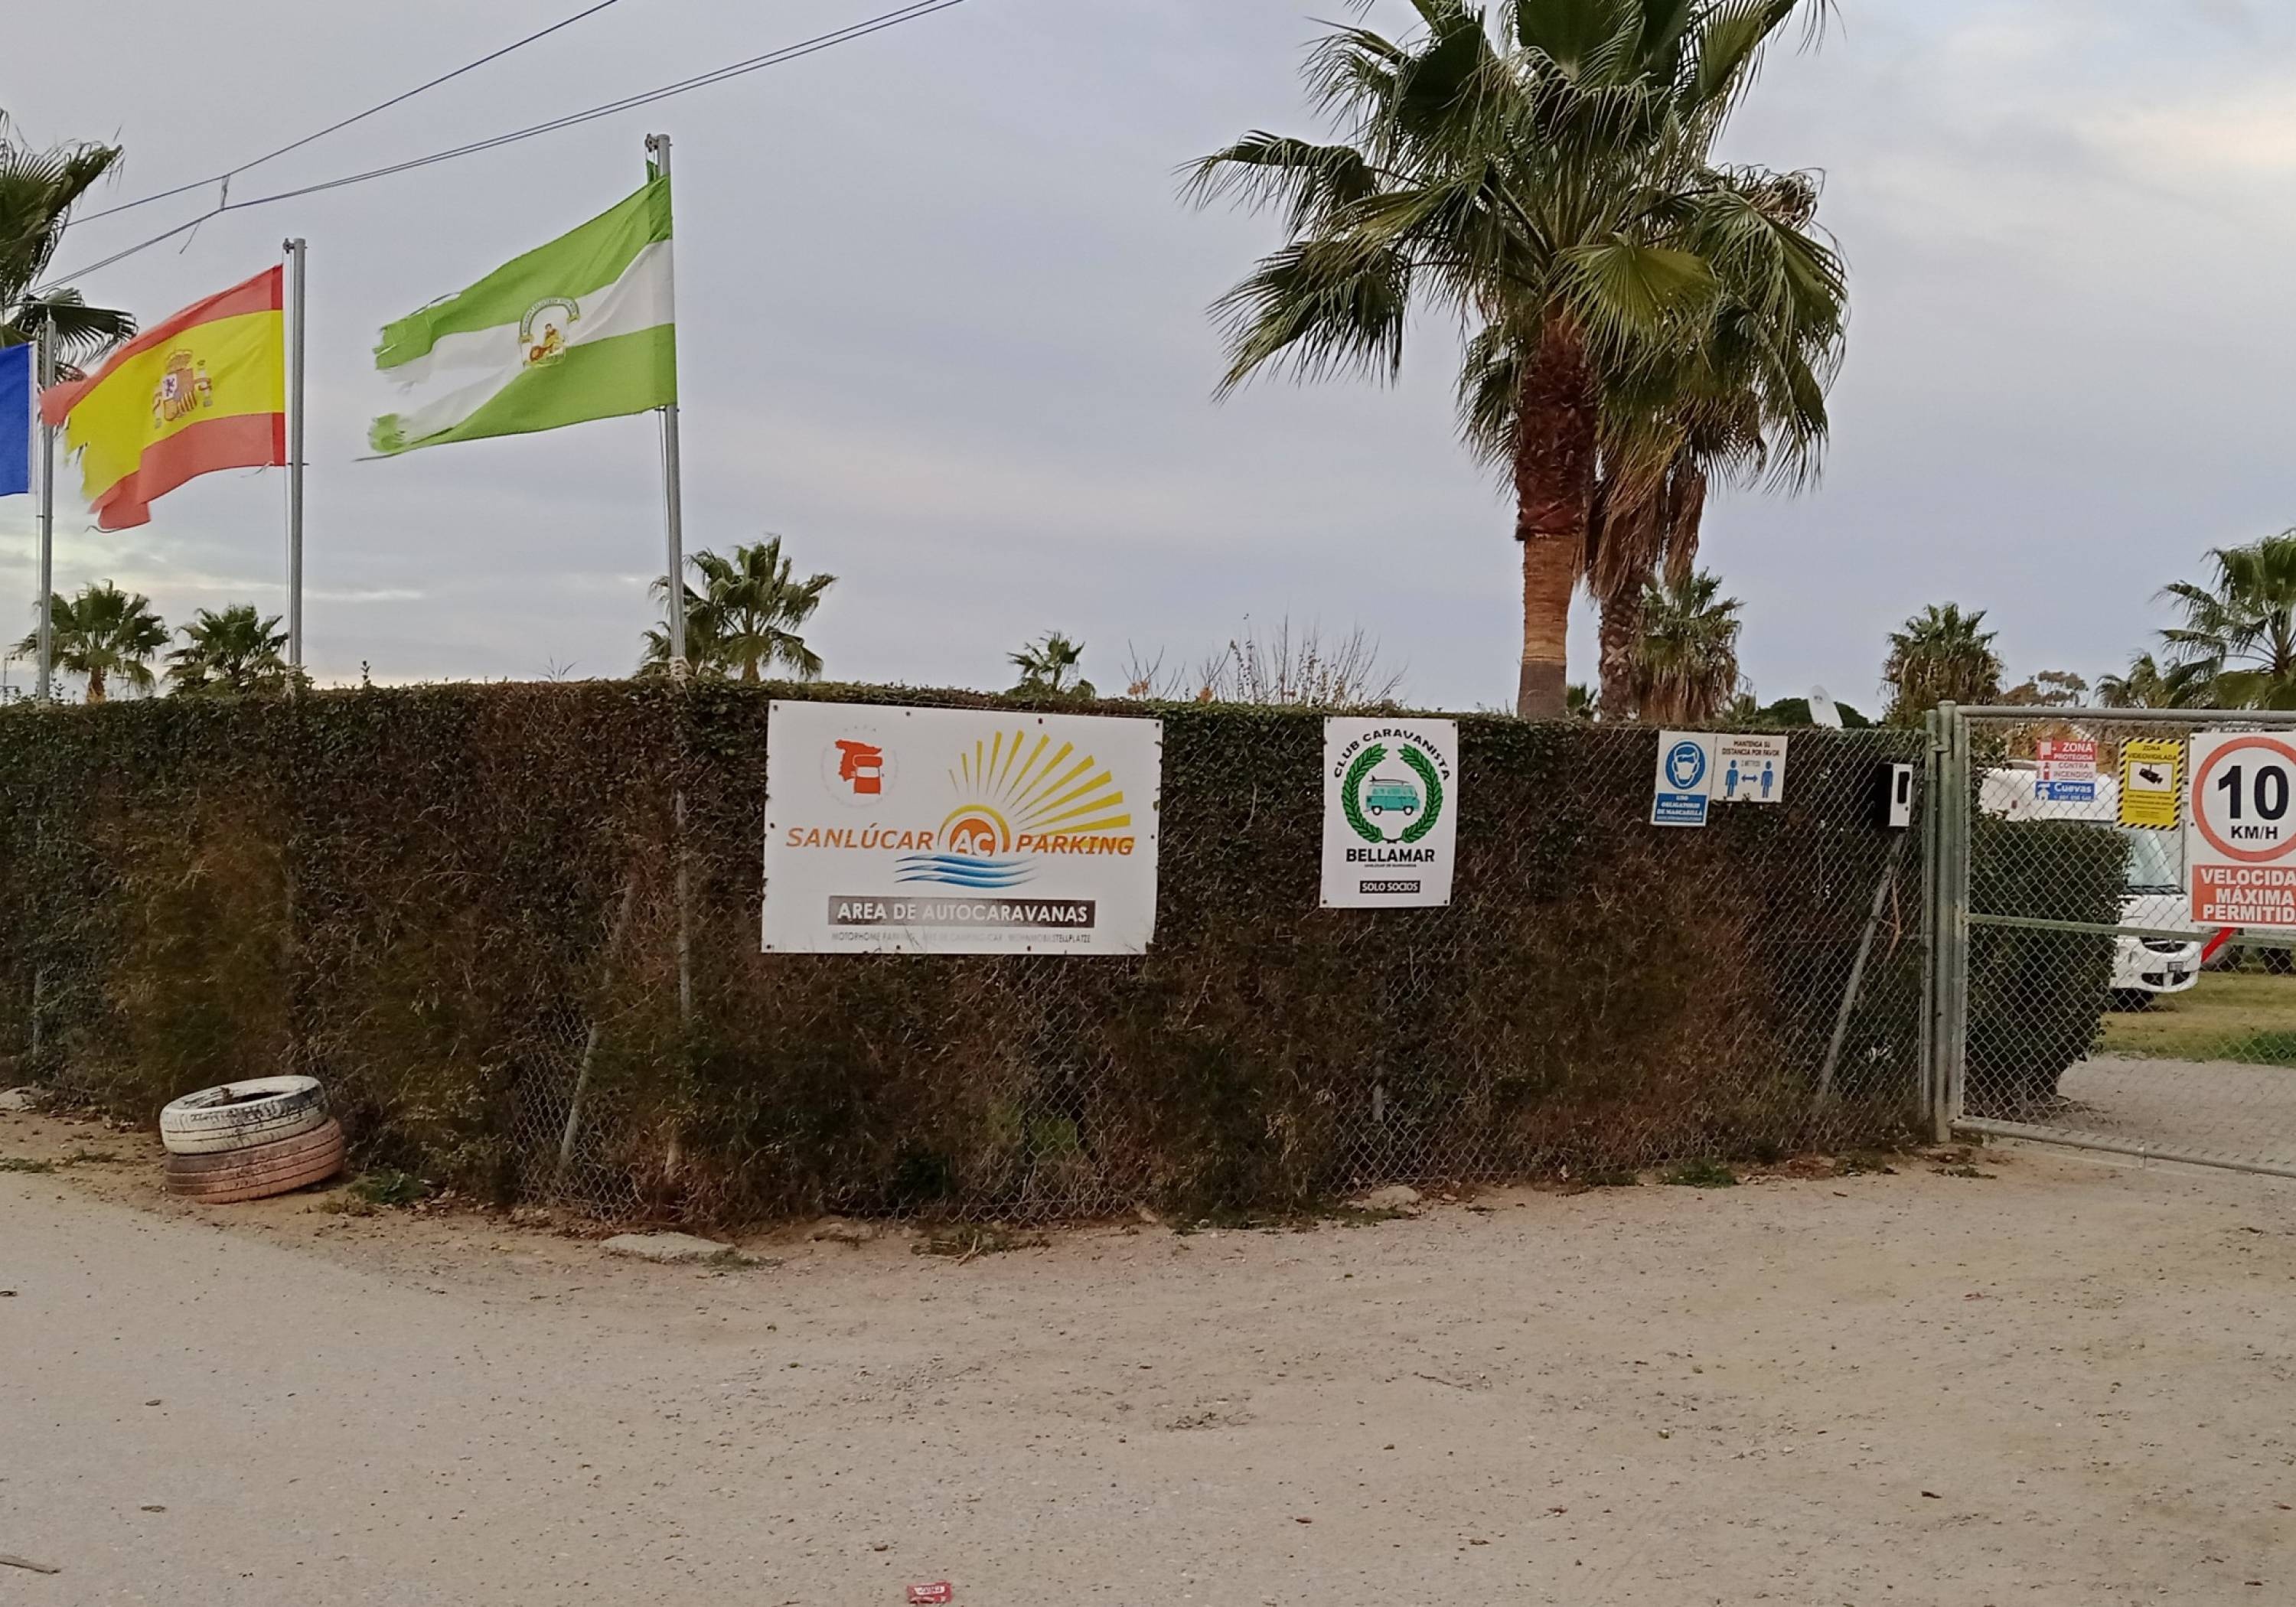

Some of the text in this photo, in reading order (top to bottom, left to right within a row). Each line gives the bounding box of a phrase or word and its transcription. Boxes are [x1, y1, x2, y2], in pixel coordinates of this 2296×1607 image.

[1722, 747, 1750, 755] DISTANCIA
[2062, 742, 2093, 753] ZONA
[1334, 729, 1451, 781] CLUB CARAVANISTA
[2053, 752, 2094, 761] PROTEGIDA
[2054, 783, 2092, 794] Cuevas
[2218, 765, 2289, 820] 10
[786, 823, 934, 850] SANLÚCAR
[1016, 834, 1135, 856] PARKING
[2231, 826, 2278, 840] KM/H
[1346, 848, 1435, 862] BELLAMAR
[1362, 882, 1419, 892] SOLO SOCIOS
[2216, 885, 2295, 906] MÁXIMA
[837, 902, 1088, 923] AREA DE AUTOCARAVANAS
[2203, 904, 2296, 923] PERMITID
